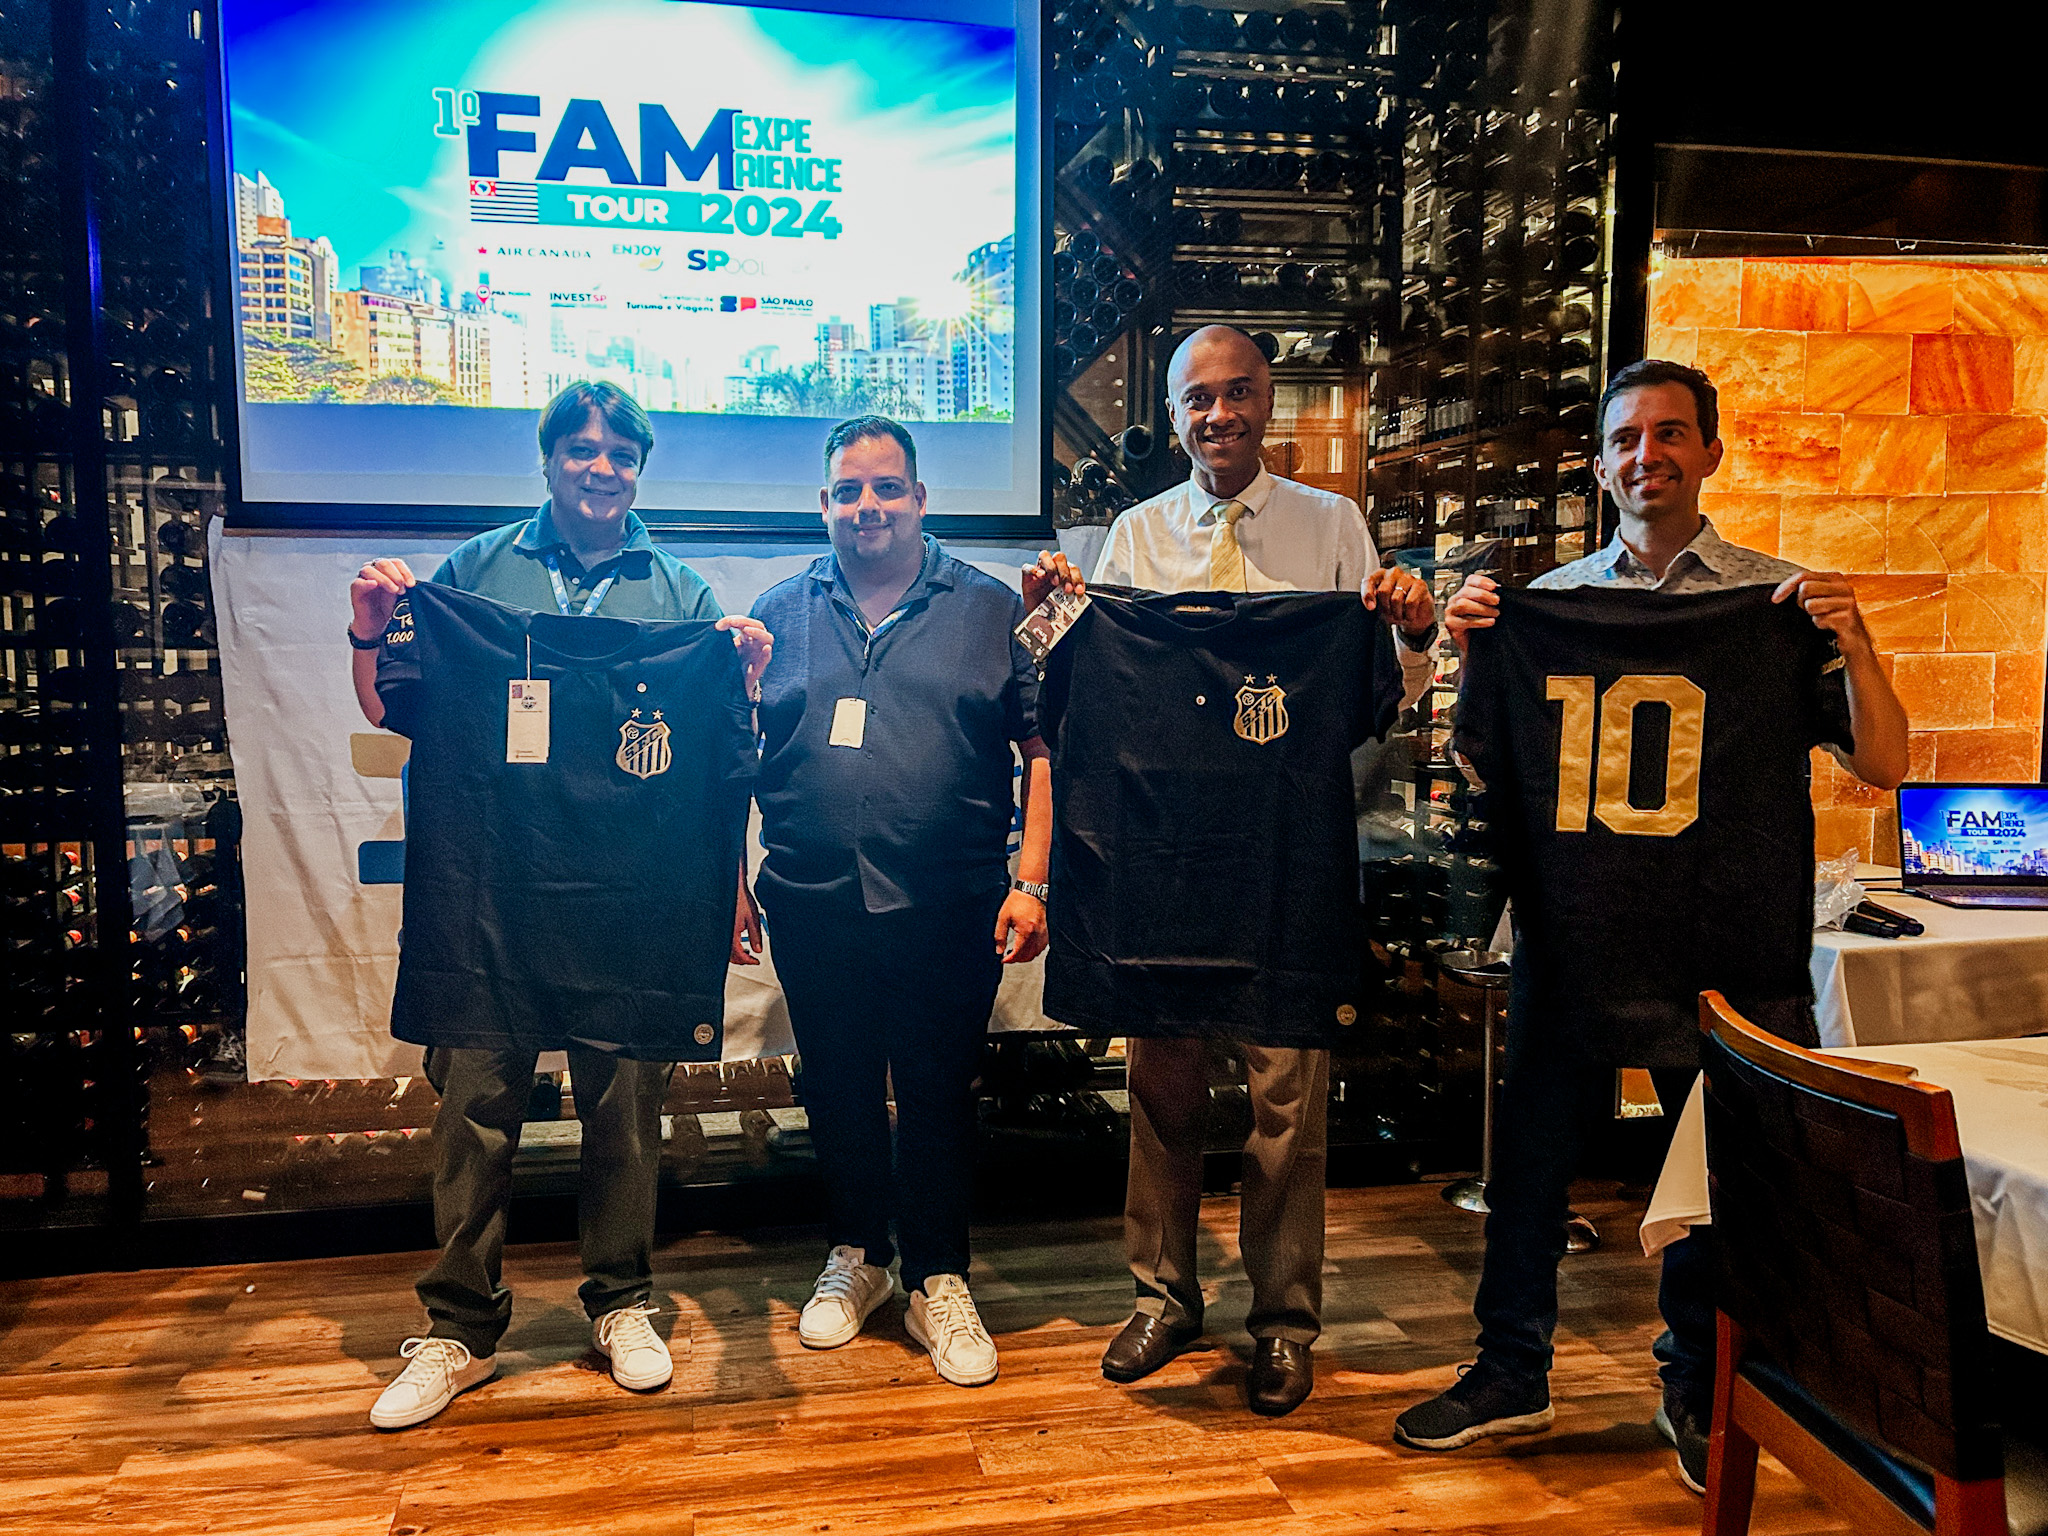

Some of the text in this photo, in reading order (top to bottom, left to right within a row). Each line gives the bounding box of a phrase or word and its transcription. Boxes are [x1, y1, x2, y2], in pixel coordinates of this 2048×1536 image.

[467, 90, 743, 191] FAM
[734, 114, 812, 154] EXPE
[735, 152, 842, 192] RIENCE
[567, 193, 842, 240] TOUR 2024
[497, 247, 591, 259] AIR CANADA
[612, 244, 662, 256] ENJOY
[626, 301, 663, 310] Turismo
[676, 303, 714, 313] Viagens
[783, 298, 814, 307] PAULO
[1546, 675, 1706, 837] 10
[1947, 810, 2002, 828] FAM
[1994, 829, 2027, 838] 2024
